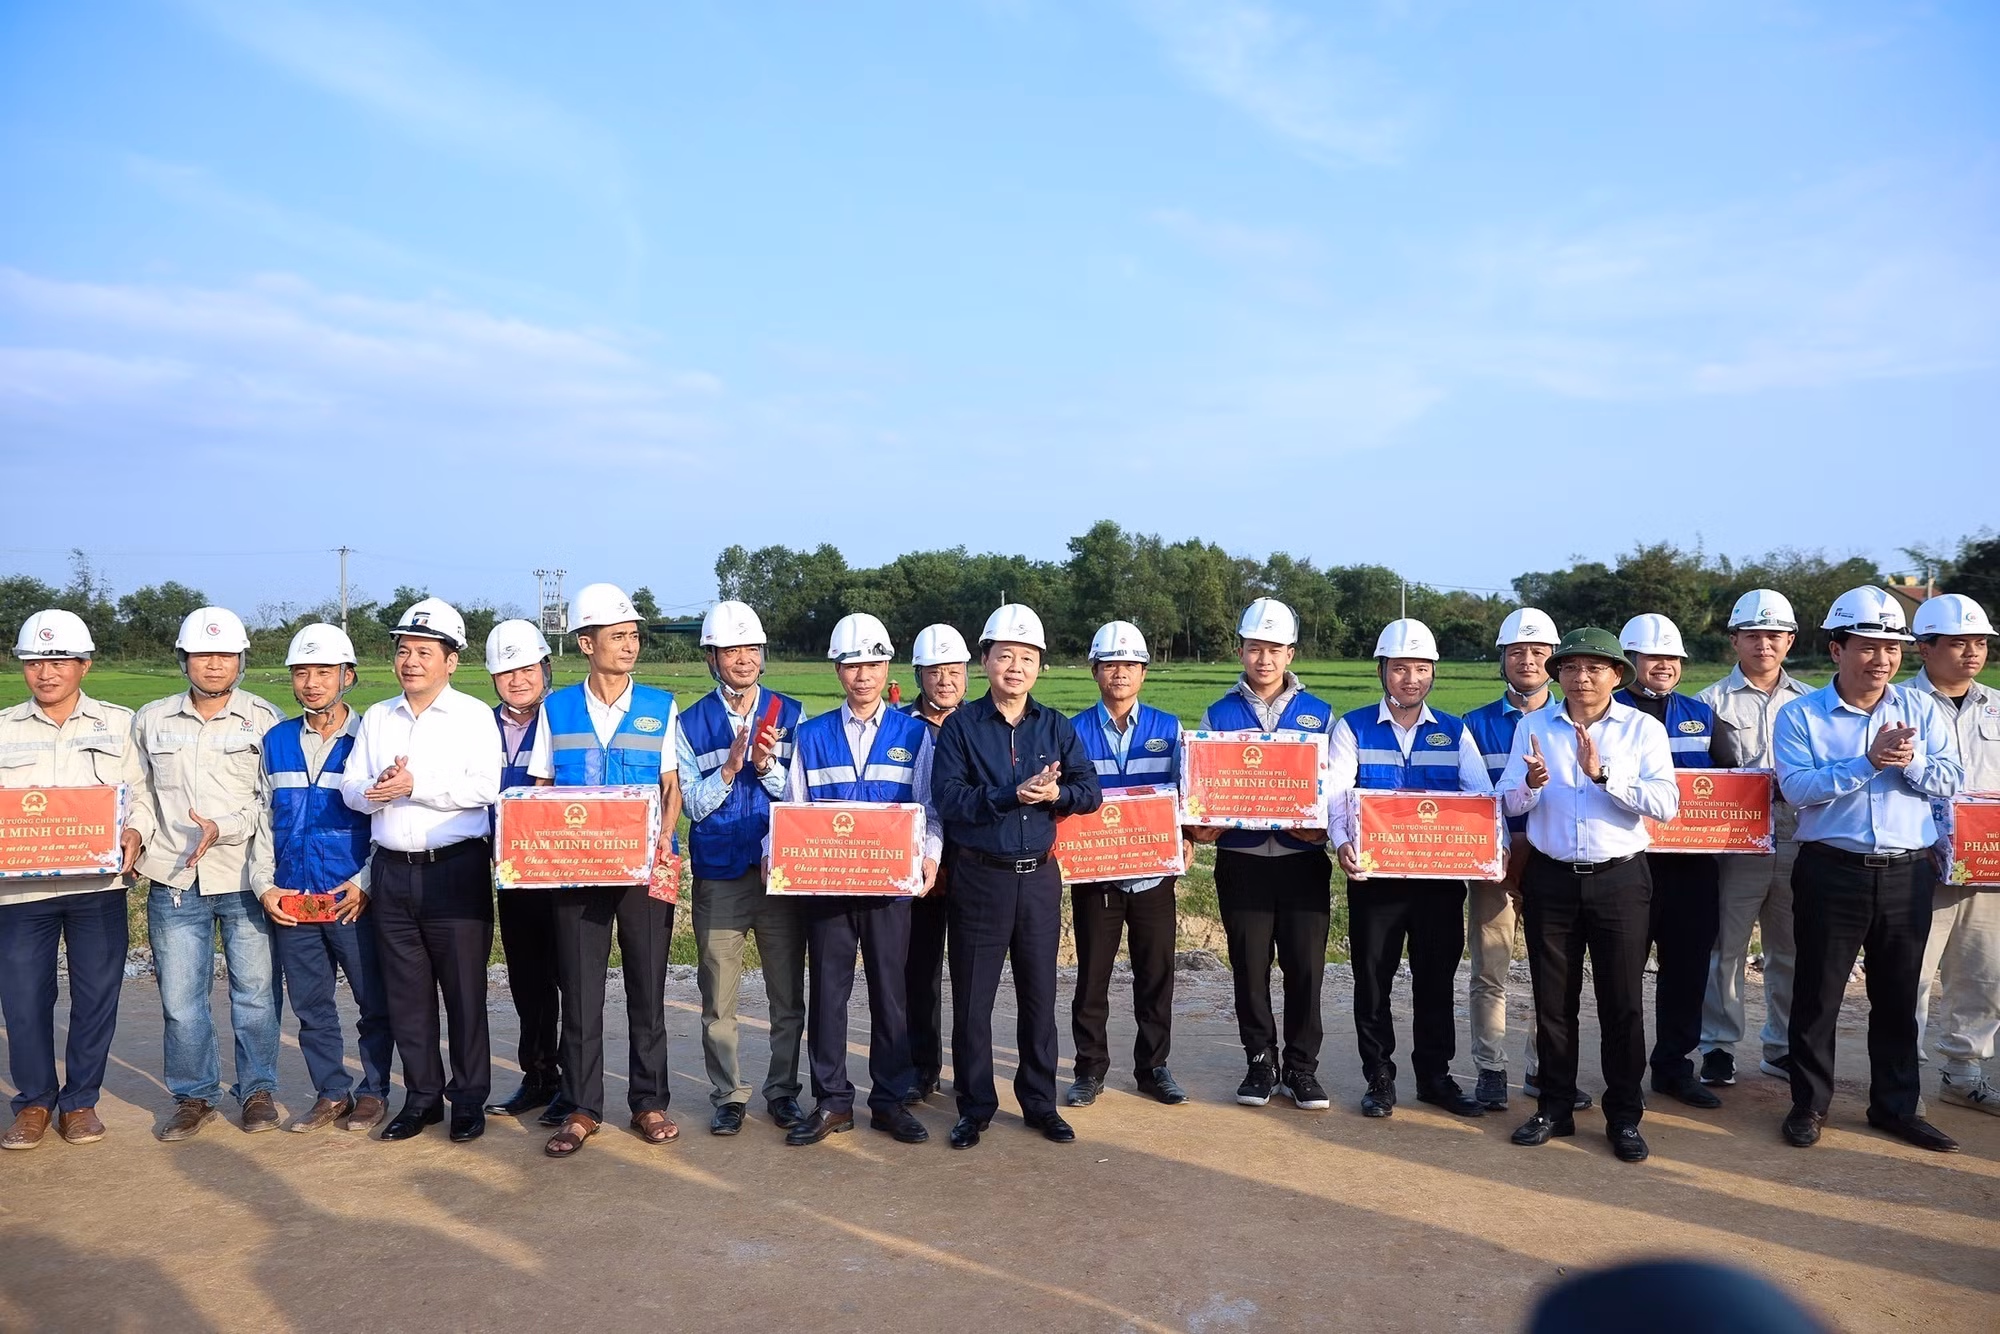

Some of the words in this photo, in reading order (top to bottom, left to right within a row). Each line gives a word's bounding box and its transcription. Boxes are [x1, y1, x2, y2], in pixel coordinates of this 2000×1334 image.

[1198, 778, 1230, 789] PHẠM
[1234, 779, 1265, 787] MINH
[1270, 777, 1309, 788] CHÍNH
[1684, 809, 1718, 819] MINH
[1721, 808, 1761, 819] CHÍNH
[9, 826, 51, 837] MINH
[56, 824, 105, 836] CHÍNH
[511, 840, 550, 852] PHẠM
[554, 840, 590, 849] MINH
[594, 836, 638, 849] CHÍNH
[1059, 840, 1093, 851] PHẠM
[1096, 837, 1126, 847] MINH
[1130, 832, 1168, 844] CHÍNH
[1369, 832, 1404, 844] PHẠM
[1408, 833, 1442, 843] MINH
[1446, 832, 1487, 844] CHÍNH
[782, 847, 819, 860] PHẠM
[822, 848, 857, 858] MINH
[861, 846, 904, 860] CHÍNH
[1964, 842, 2000, 854] PHẠM
